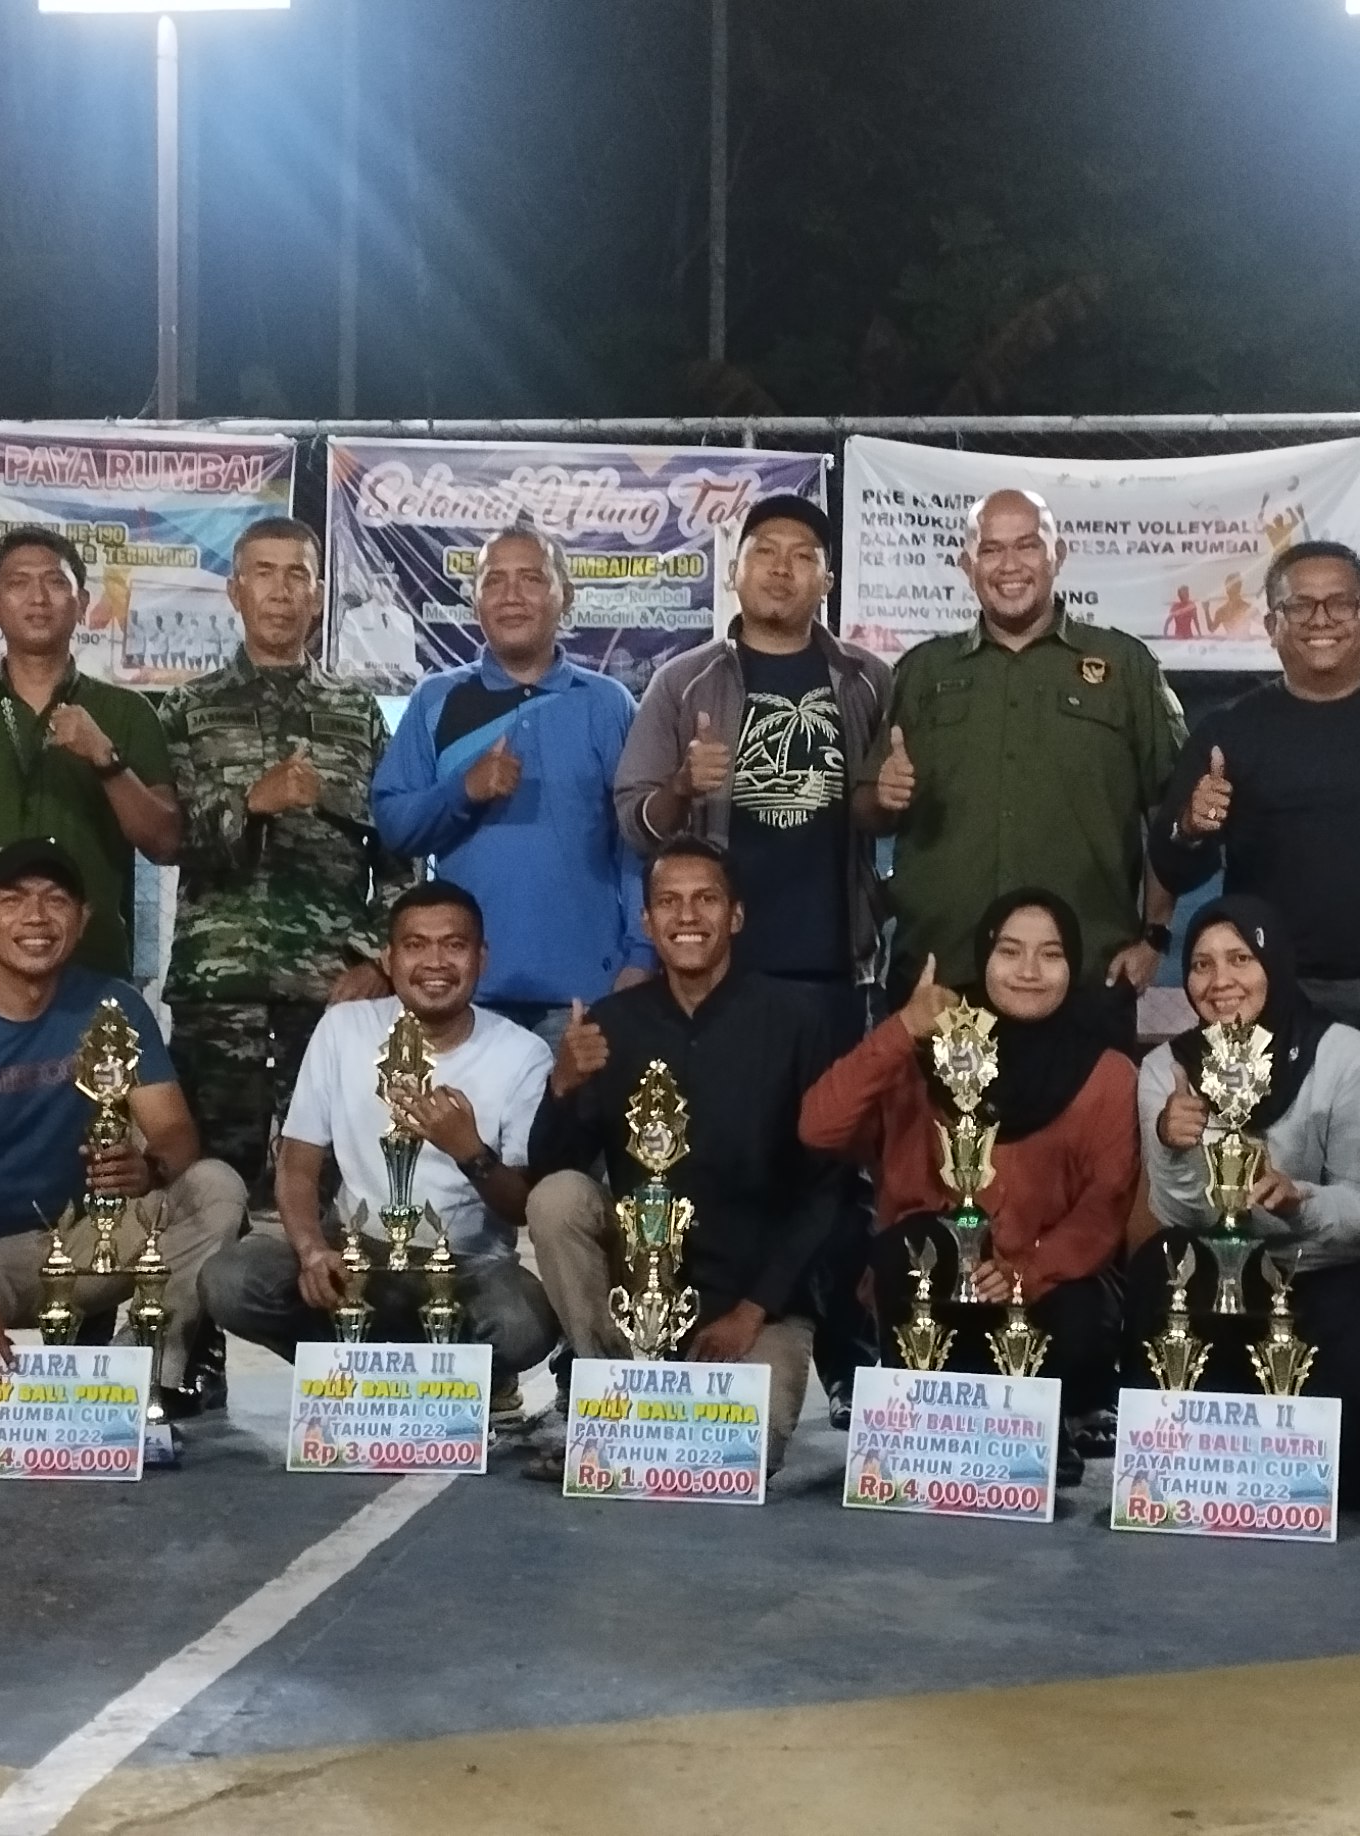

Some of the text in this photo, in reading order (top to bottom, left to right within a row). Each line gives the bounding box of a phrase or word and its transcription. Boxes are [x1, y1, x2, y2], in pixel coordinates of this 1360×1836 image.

[5, 446, 98, 487] PAYA
[106, 450, 263, 493] RUMBAI
[1126, 540, 1174, 554] PAYA
[633, 554, 703, 578] KE-190
[586, 589, 688, 607] Paya Rumbai
[578, 609, 714, 630] Mandiri & Agamis
[93, 1354, 109, 1376] II
[339, 1351, 455, 1373] JUARA III
[301, 1380, 480, 1399] VOLLY BALL PUTRA
[614, 1369, 733, 1395] JUARA IV
[18, 1385, 69, 1403] BALL
[74, 1385, 138, 1403] PUTRA
[907, 1379, 1012, 1408] JUARA I
[87, 1407, 120, 1421] CUP
[128, 1408, 139, 1421] V
[300, 1403, 482, 1417] PAYARUMBAI CUP V
[577, 1398, 759, 1424] VOLLY BALL PUTRA
[1171, 1400, 1295, 1428] JUARA II
[332, 1422, 446, 1437] TAHUN 2022
[575, 1423, 759, 1443] PAYARUMBAI CUP V
[863, 1409, 1044, 1438] VOLLY BALL PUTRI
[55, 1429, 103, 1443] 2022
[858, 1432, 1048, 1459] PAYARUMBAI CUP V
[1129, 1431, 1326, 1456] VOLLY BALL PUTRI
[0, 1447, 130, 1469] 4.000.000
[303, 1441, 474, 1464] Rp 3.000.000
[607, 1445, 722, 1464] TAHUN 2022
[891, 1457, 1009, 1479] TAHUN 2022
[1124, 1454, 1330, 1478] PAYARUMBAI CUP V
[579, 1464, 753, 1492] Rp 1.000.000
[1160, 1477, 1288, 1498] TAHUN 2022
[860, 1475, 1040, 1508] Rp 4.000.000
[1128, 1497, 1323, 1529] Rp 3.000.000
